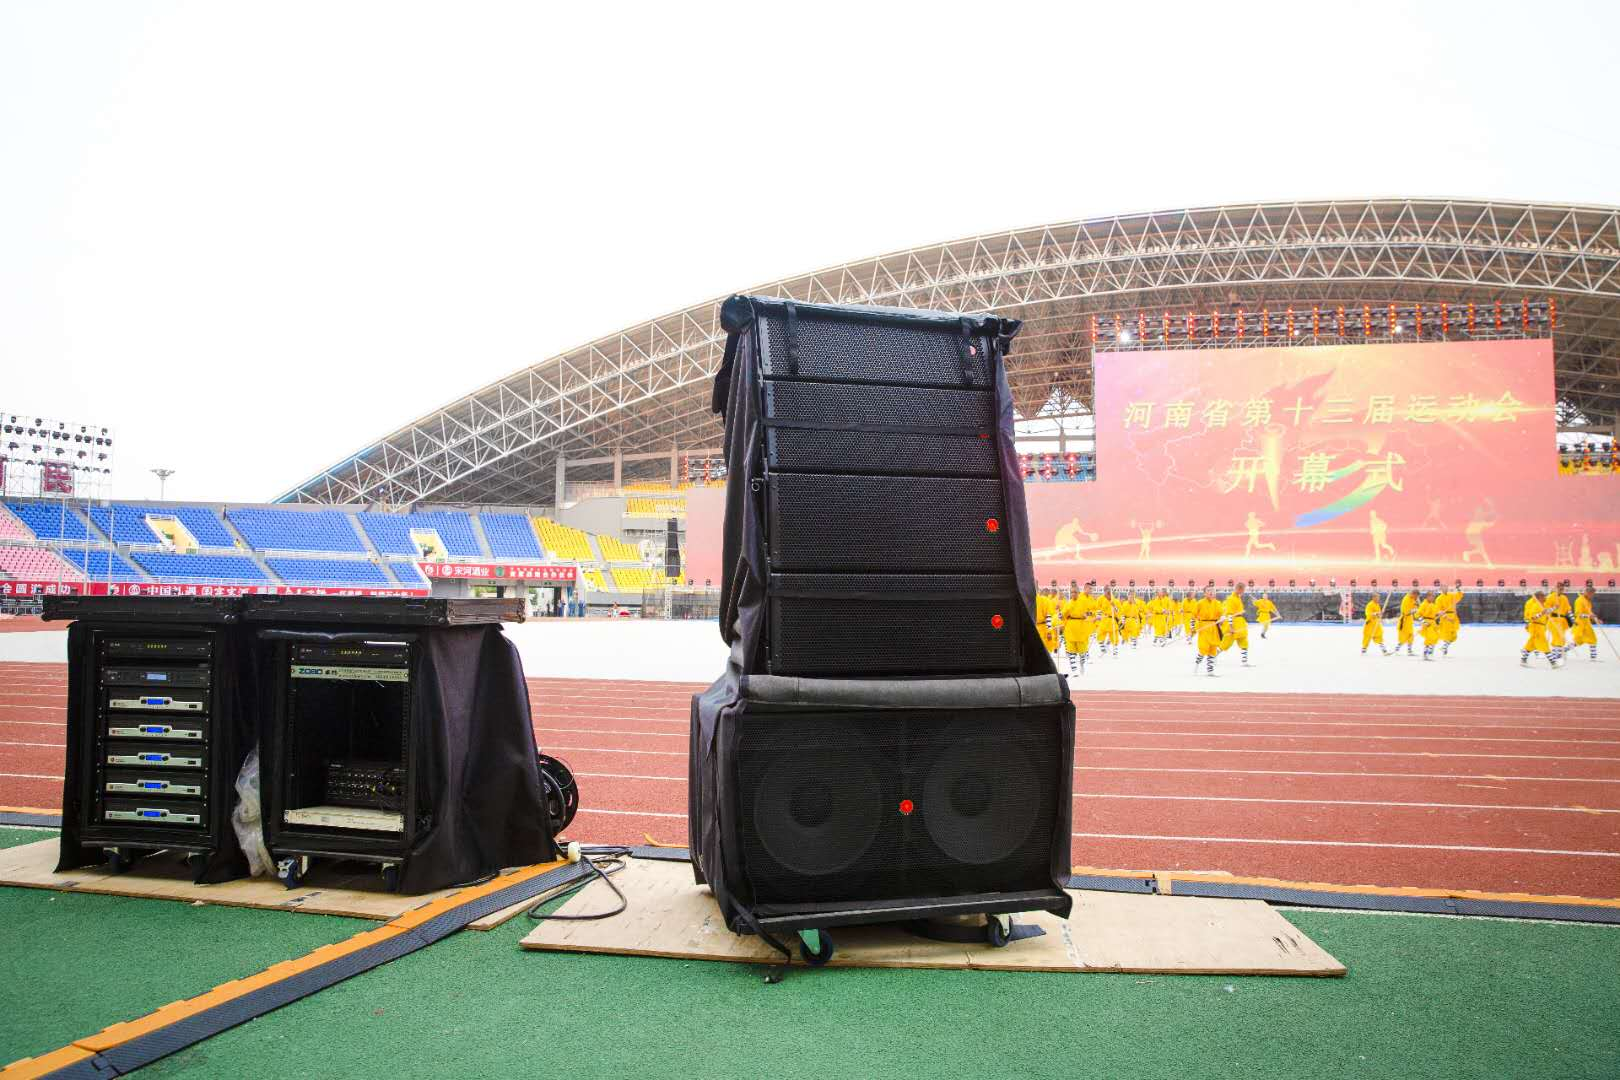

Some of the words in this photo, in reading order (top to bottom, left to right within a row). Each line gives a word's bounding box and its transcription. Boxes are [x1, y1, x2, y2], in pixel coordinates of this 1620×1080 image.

[1123, 391, 1524, 429] 河南省第十三届运动会
[1222, 452, 1407, 496] 开幕式
[454, 566, 490, 577] 宋河酒业
